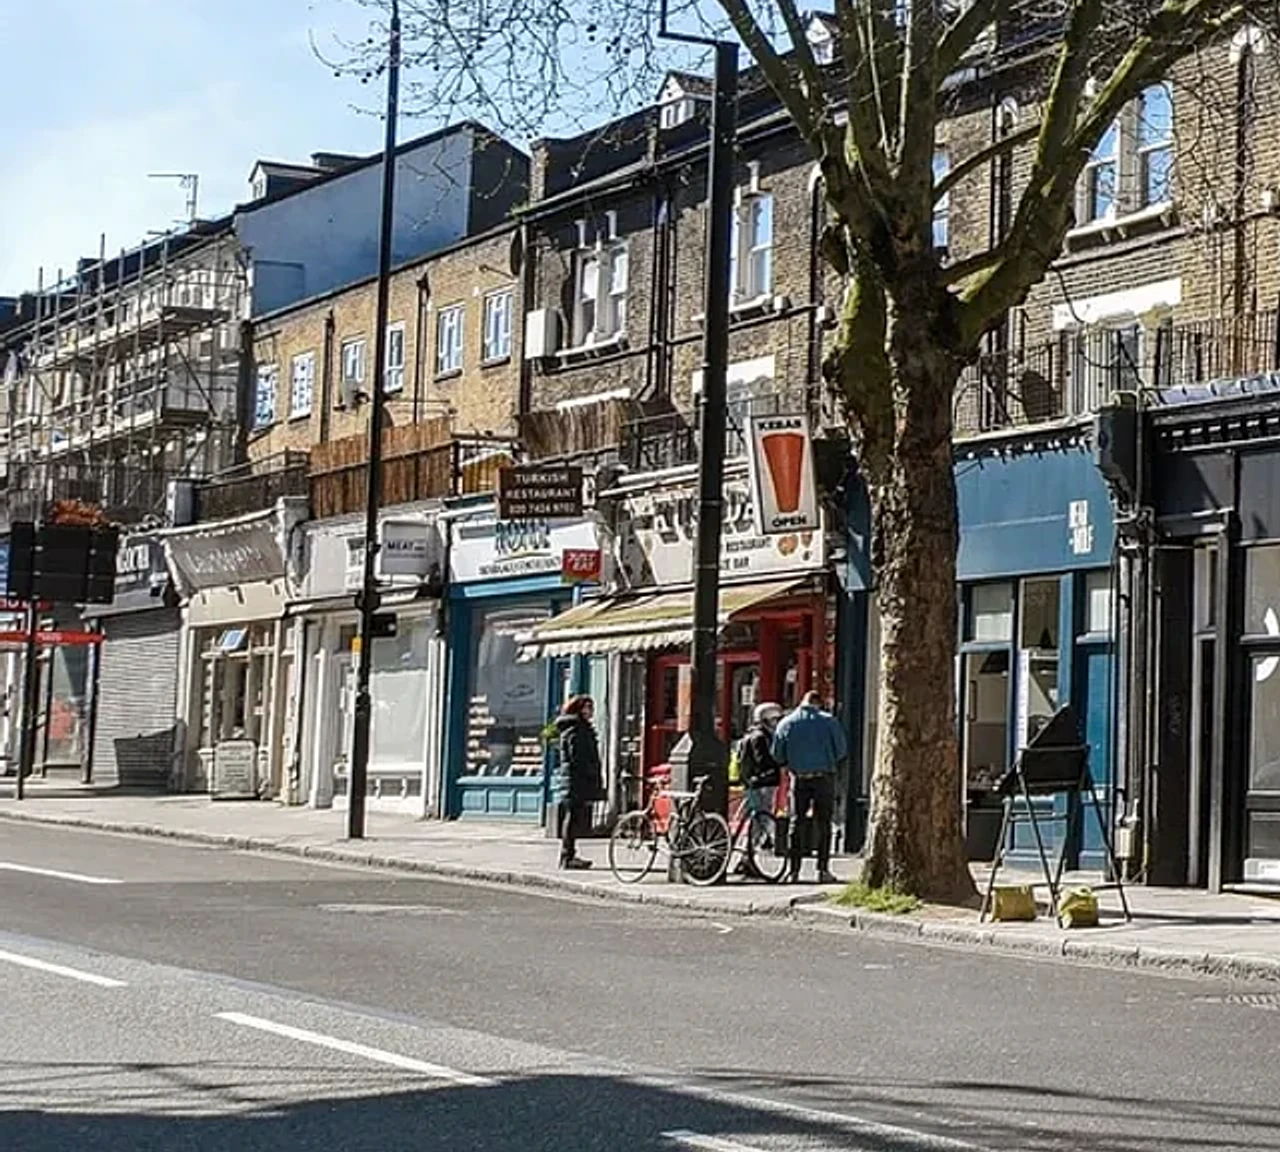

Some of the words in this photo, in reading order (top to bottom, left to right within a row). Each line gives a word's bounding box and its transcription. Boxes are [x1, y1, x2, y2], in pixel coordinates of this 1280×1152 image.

[758, 419, 802, 431] KEBAB
[514, 472, 569, 485] TURKISH
[505, 488, 577, 501] RESTAURANT
[772, 515, 808, 528] OPEN
